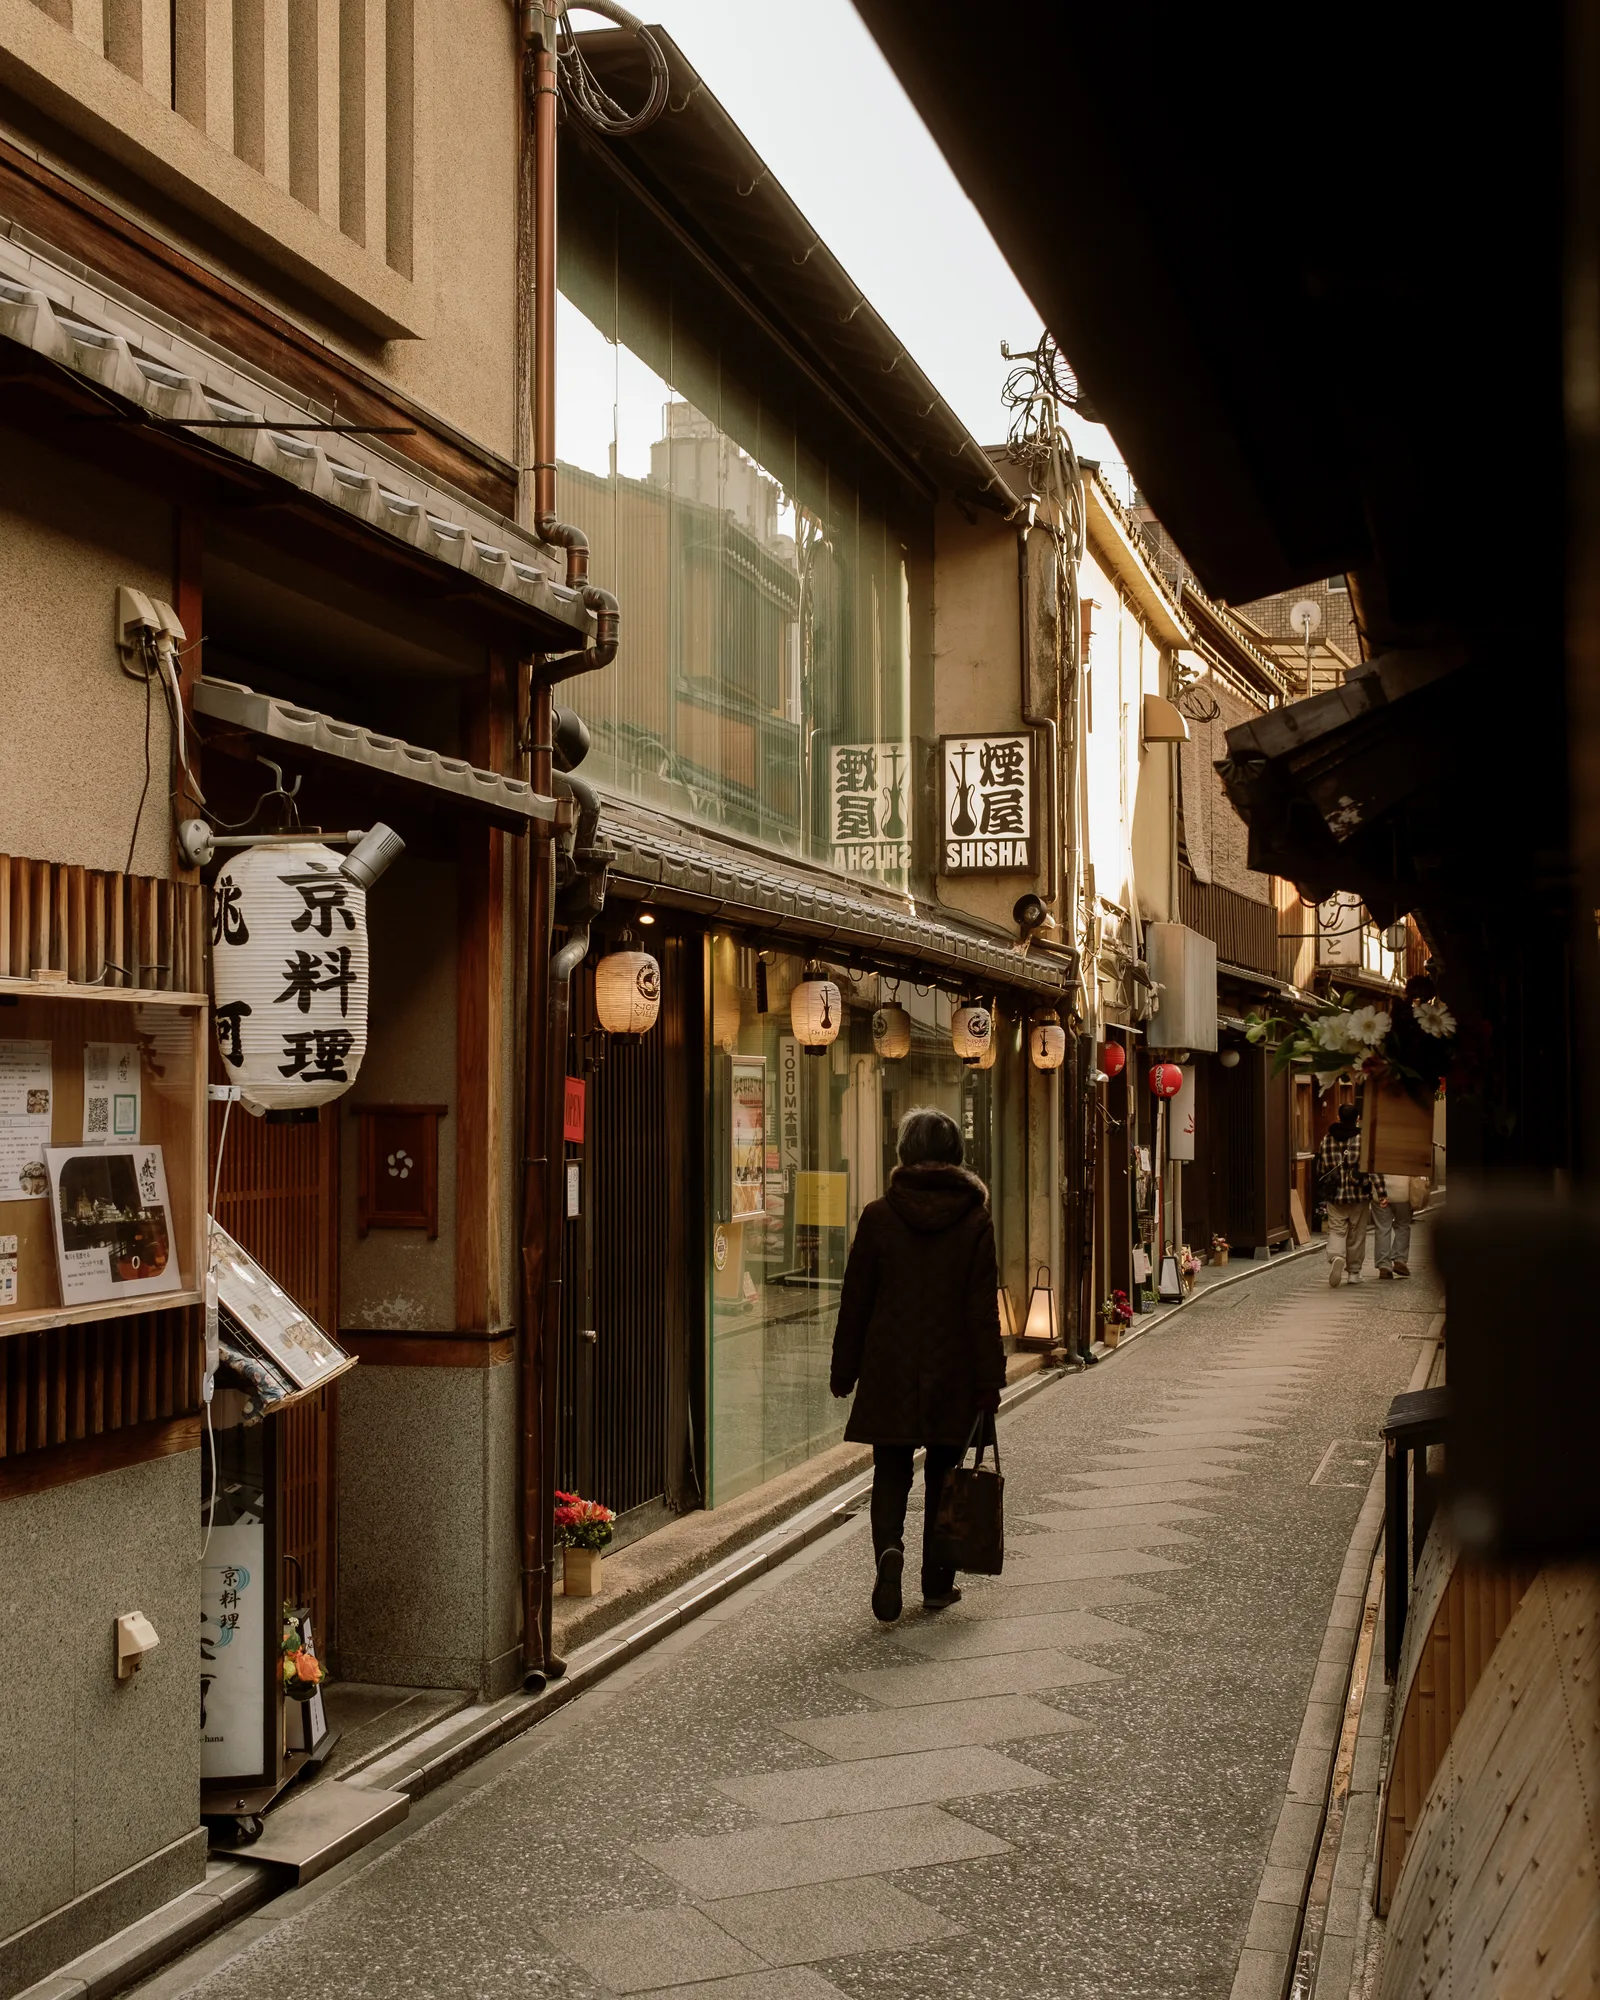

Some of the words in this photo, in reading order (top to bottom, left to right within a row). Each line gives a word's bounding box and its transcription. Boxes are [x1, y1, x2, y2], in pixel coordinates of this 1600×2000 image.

[979, 740, 1025, 836] 煙屋
[946, 840, 1028, 868] SHISHA
[273, 862, 357, 1083] 京料理
[566, 1093, 582, 1128] OPEN
[220, 1566, 241, 1630] 京料理
